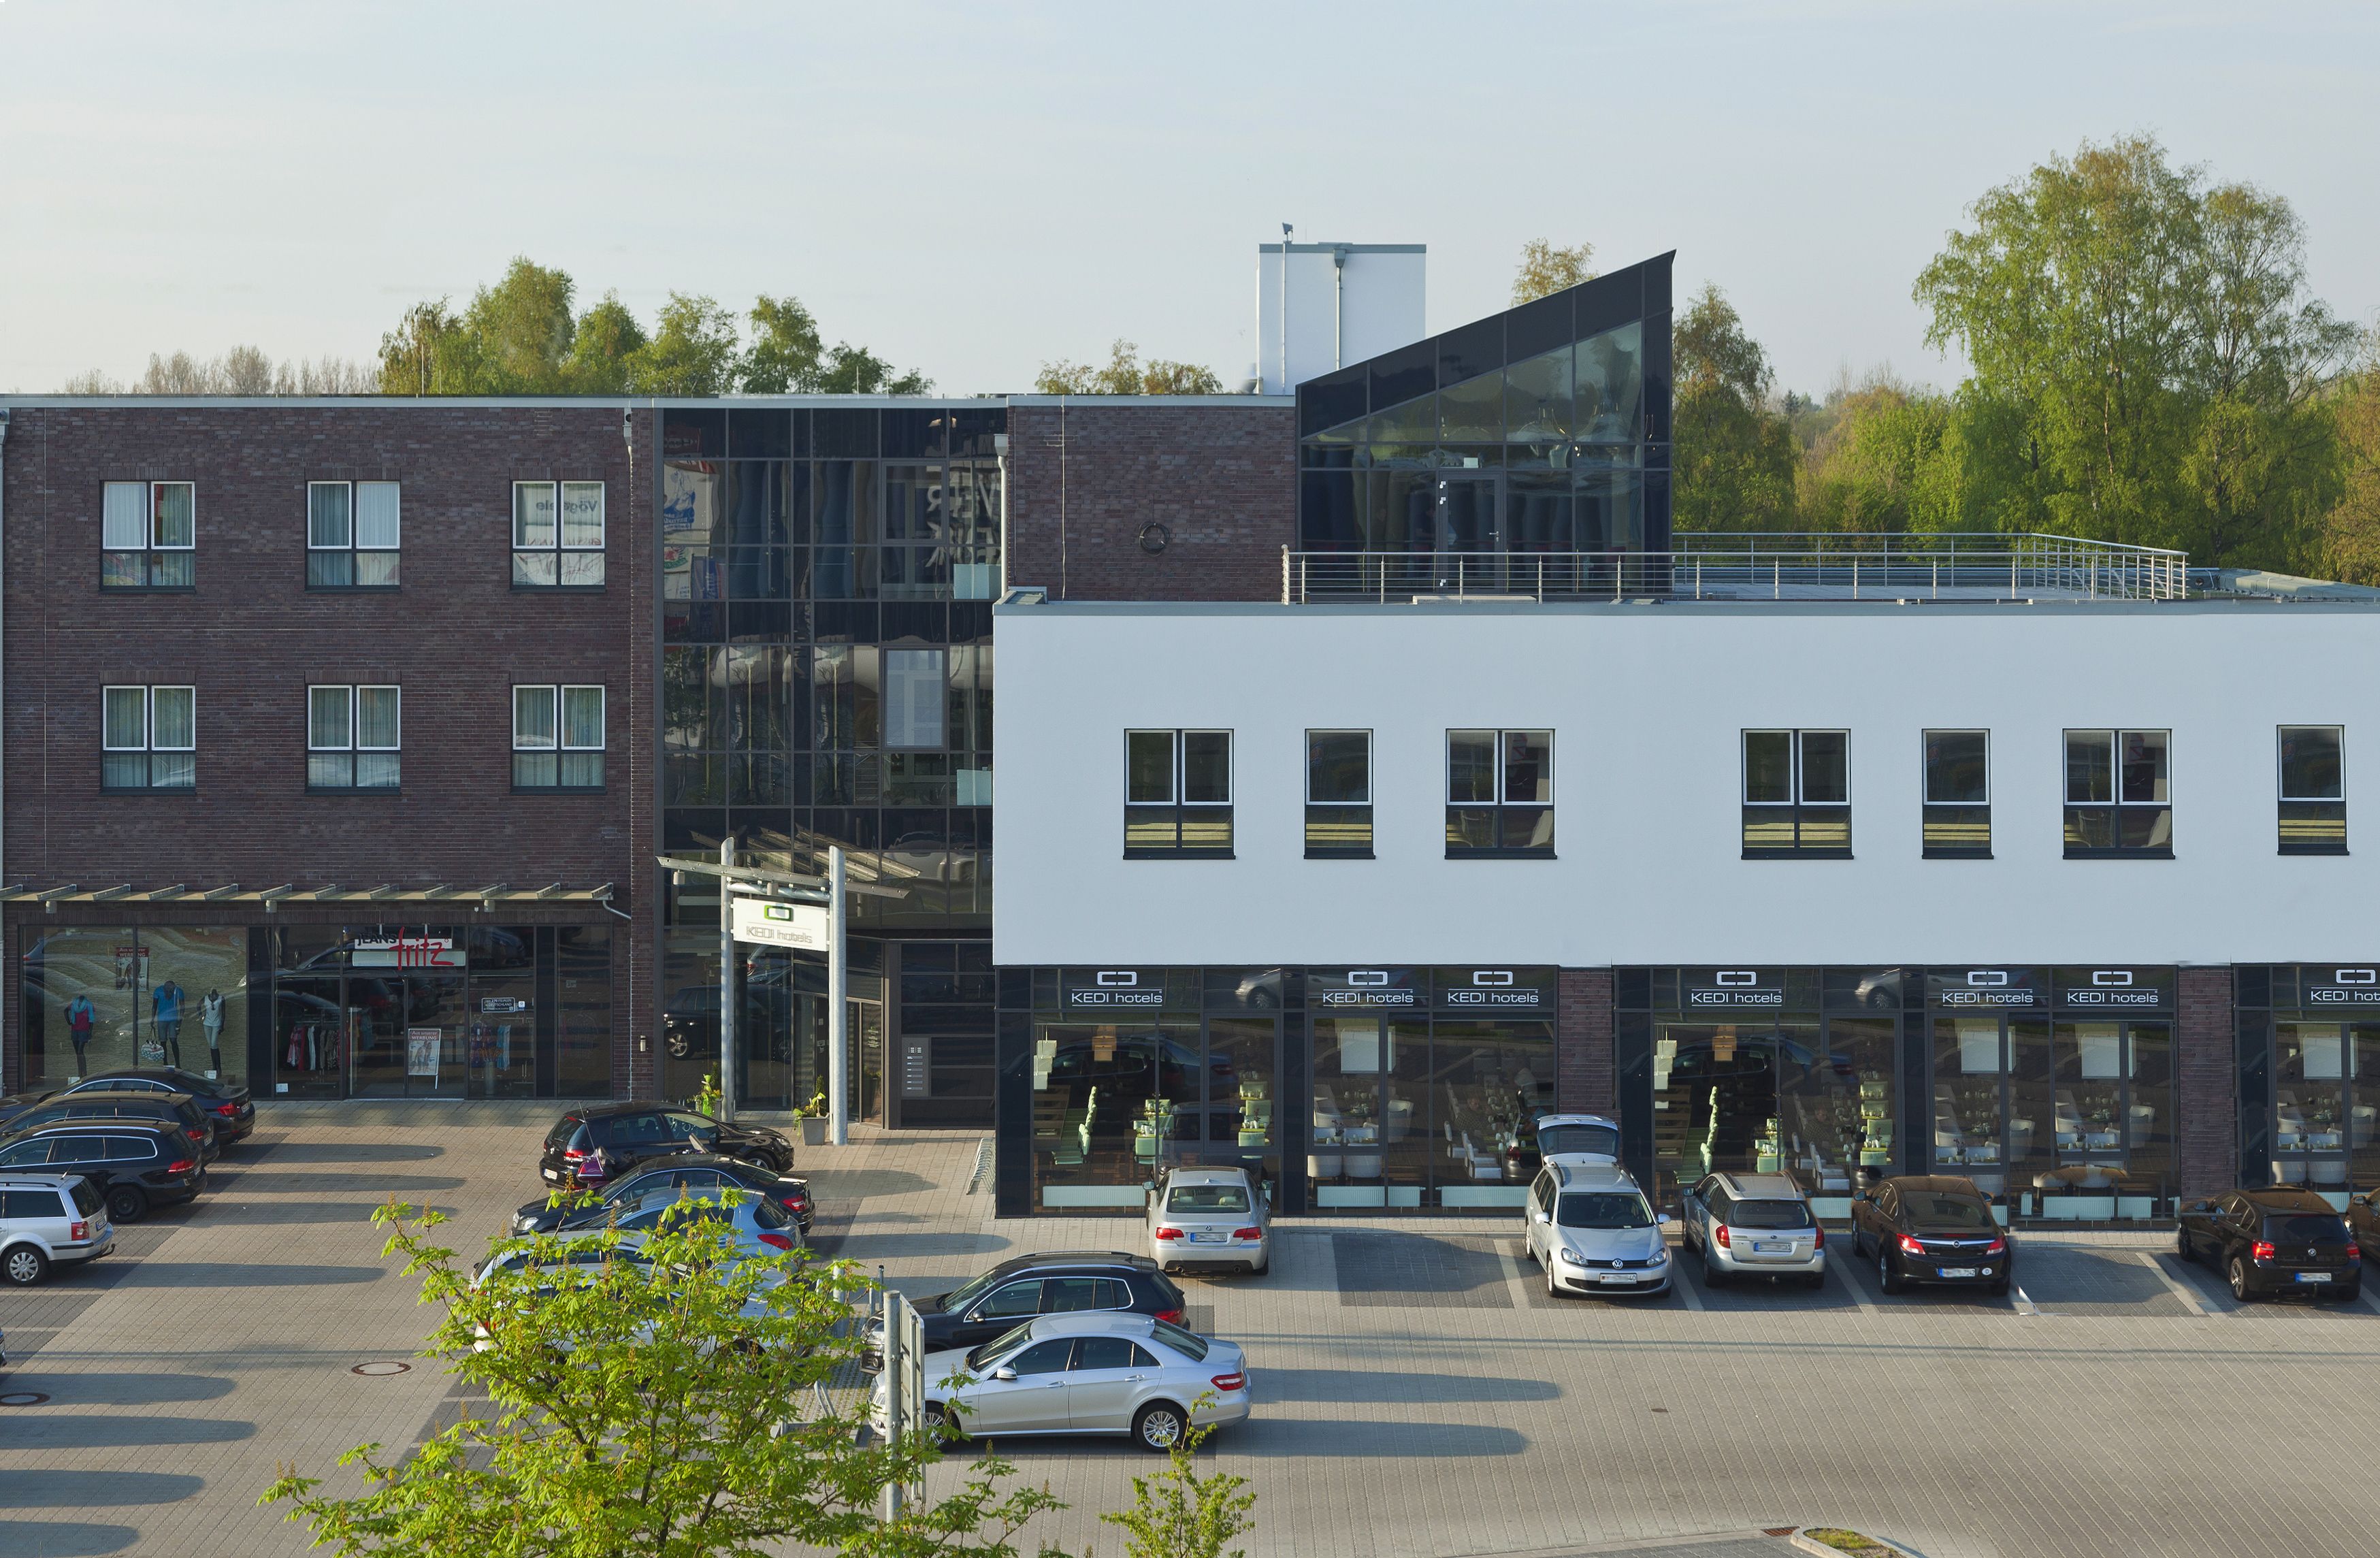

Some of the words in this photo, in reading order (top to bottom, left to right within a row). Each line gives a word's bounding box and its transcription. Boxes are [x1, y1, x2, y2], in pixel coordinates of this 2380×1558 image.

[357, 933, 397, 946] JEANS
[747, 926, 775, 939] KEDI
[777, 930, 813, 943] hotels
[389, 926, 454, 971] fritz
[1072, 992, 1109, 1003] KEDI
[1115, 992, 1162, 1003] hotels
[1323, 992, 1360, 1003] KEDI
[1367, 992, 1414, 1003] hotels
[1448, 992, 1485, 1003] KEDI
[1492, 992, 1539, 1003] hotels
[1691, 992, 1728, 1003] KEDI
[1735, 992, 1782, 1003] hotels
[1942, 992, 1980, 1003] KEDI
[1986, 992, 2033, 1003] hotels
[2068, 992, 2104, 1003] KEDI
[2111, 992, 2158, 1003] hotels
[2311, 991, 2348, 1001] KEDI
[2355, 991, 2380, 1001] hot
